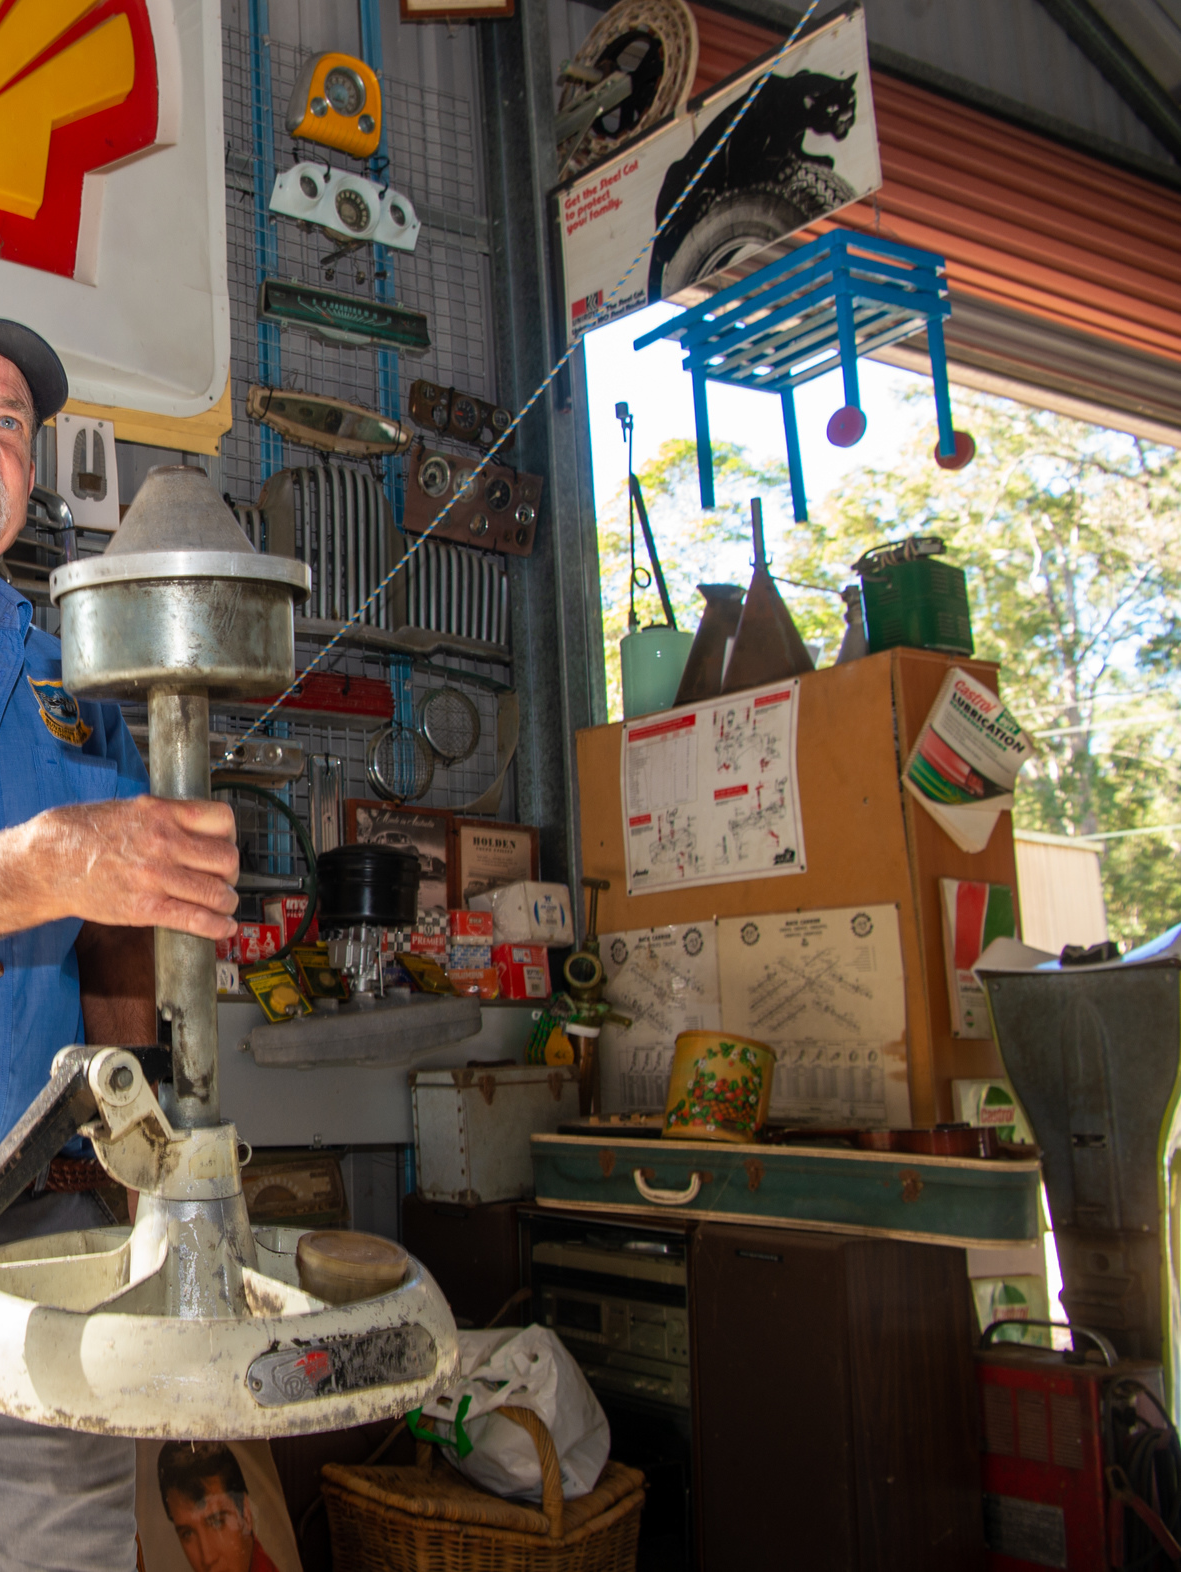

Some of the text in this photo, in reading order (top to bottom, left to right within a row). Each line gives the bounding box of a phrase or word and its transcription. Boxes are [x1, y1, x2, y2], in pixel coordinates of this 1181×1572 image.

[564, 159, 639, 210] Get the Steel Cat
[565, 189, 610, 222] to protect
[567, 216, 588, 237] your
[954, 680, 997, 714] Castrol
[952, 692, 1026, 754] LUBRICATION
[473, 836, 516, 849] HOLDEN
[411, 935, 445, 946] PREMIER
[980, 1107, 1016, 1124] Castrol
